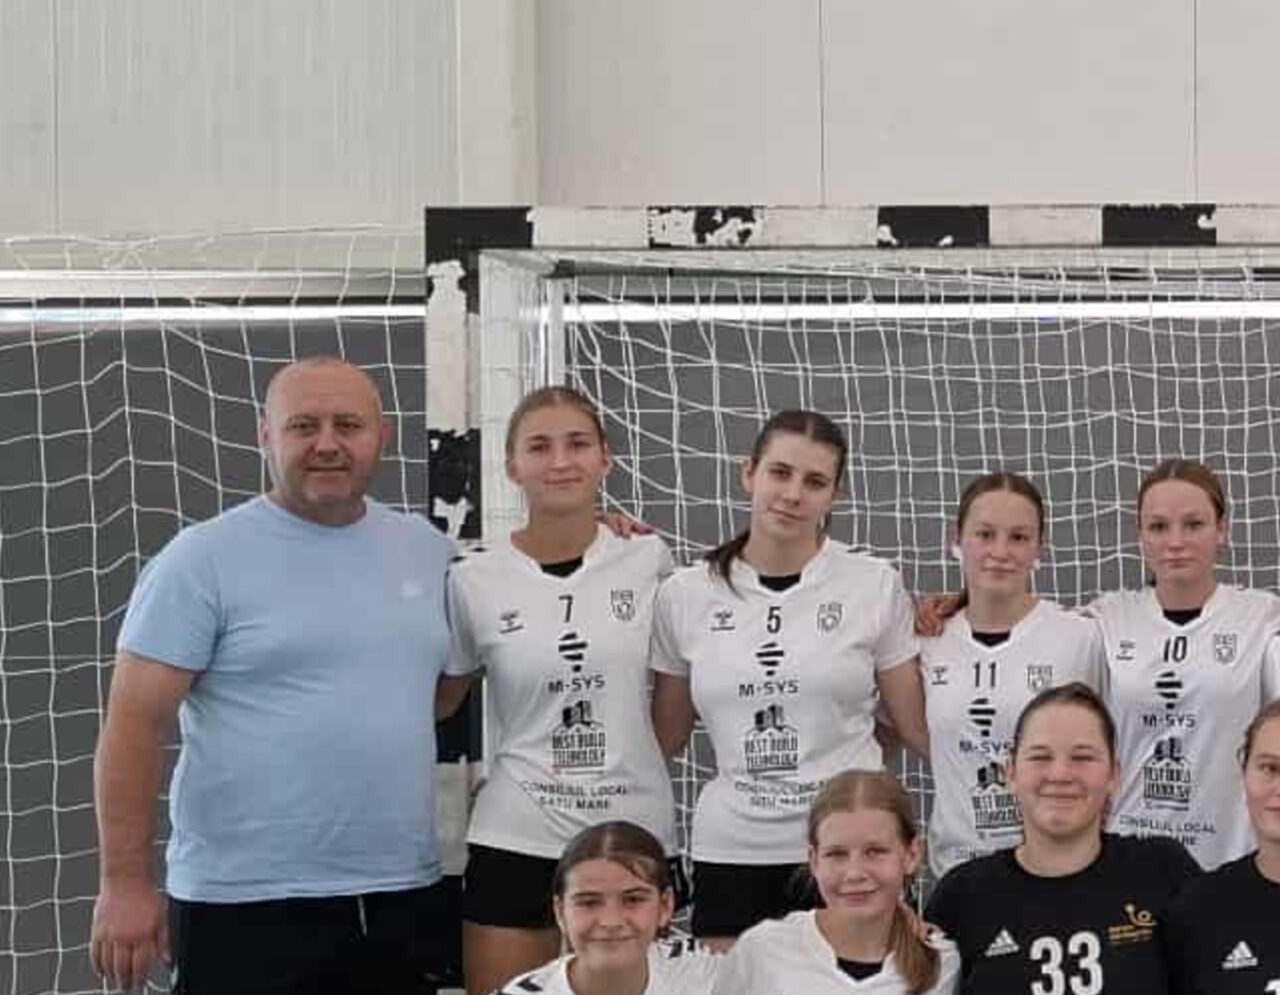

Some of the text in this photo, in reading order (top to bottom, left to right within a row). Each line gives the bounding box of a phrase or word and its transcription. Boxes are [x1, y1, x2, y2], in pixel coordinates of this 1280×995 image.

[559, 594, 574, 623] 7
[767, 605, 782, 634] 5
[1163, 636, 1188, 662] 10
[972, 661, 997, 688] 11
